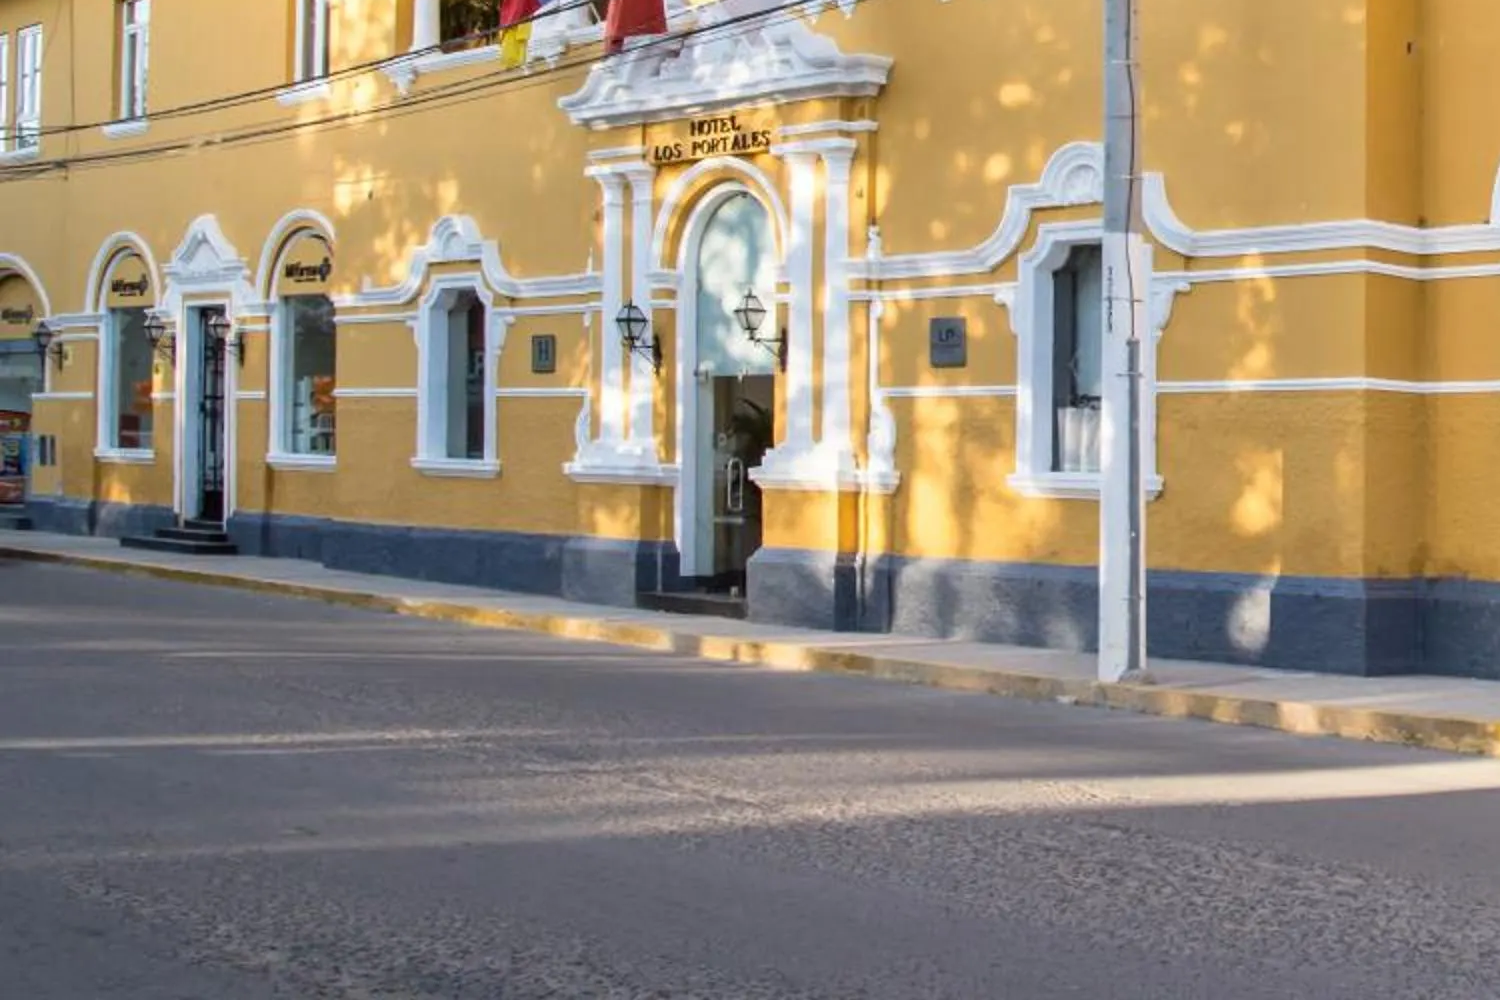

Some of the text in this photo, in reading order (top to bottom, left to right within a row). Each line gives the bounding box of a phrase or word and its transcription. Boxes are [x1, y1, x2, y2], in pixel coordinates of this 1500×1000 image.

[690, 115, 741, 136] HOTEL
[654, 130, 771, 161] LOS PORTALES
